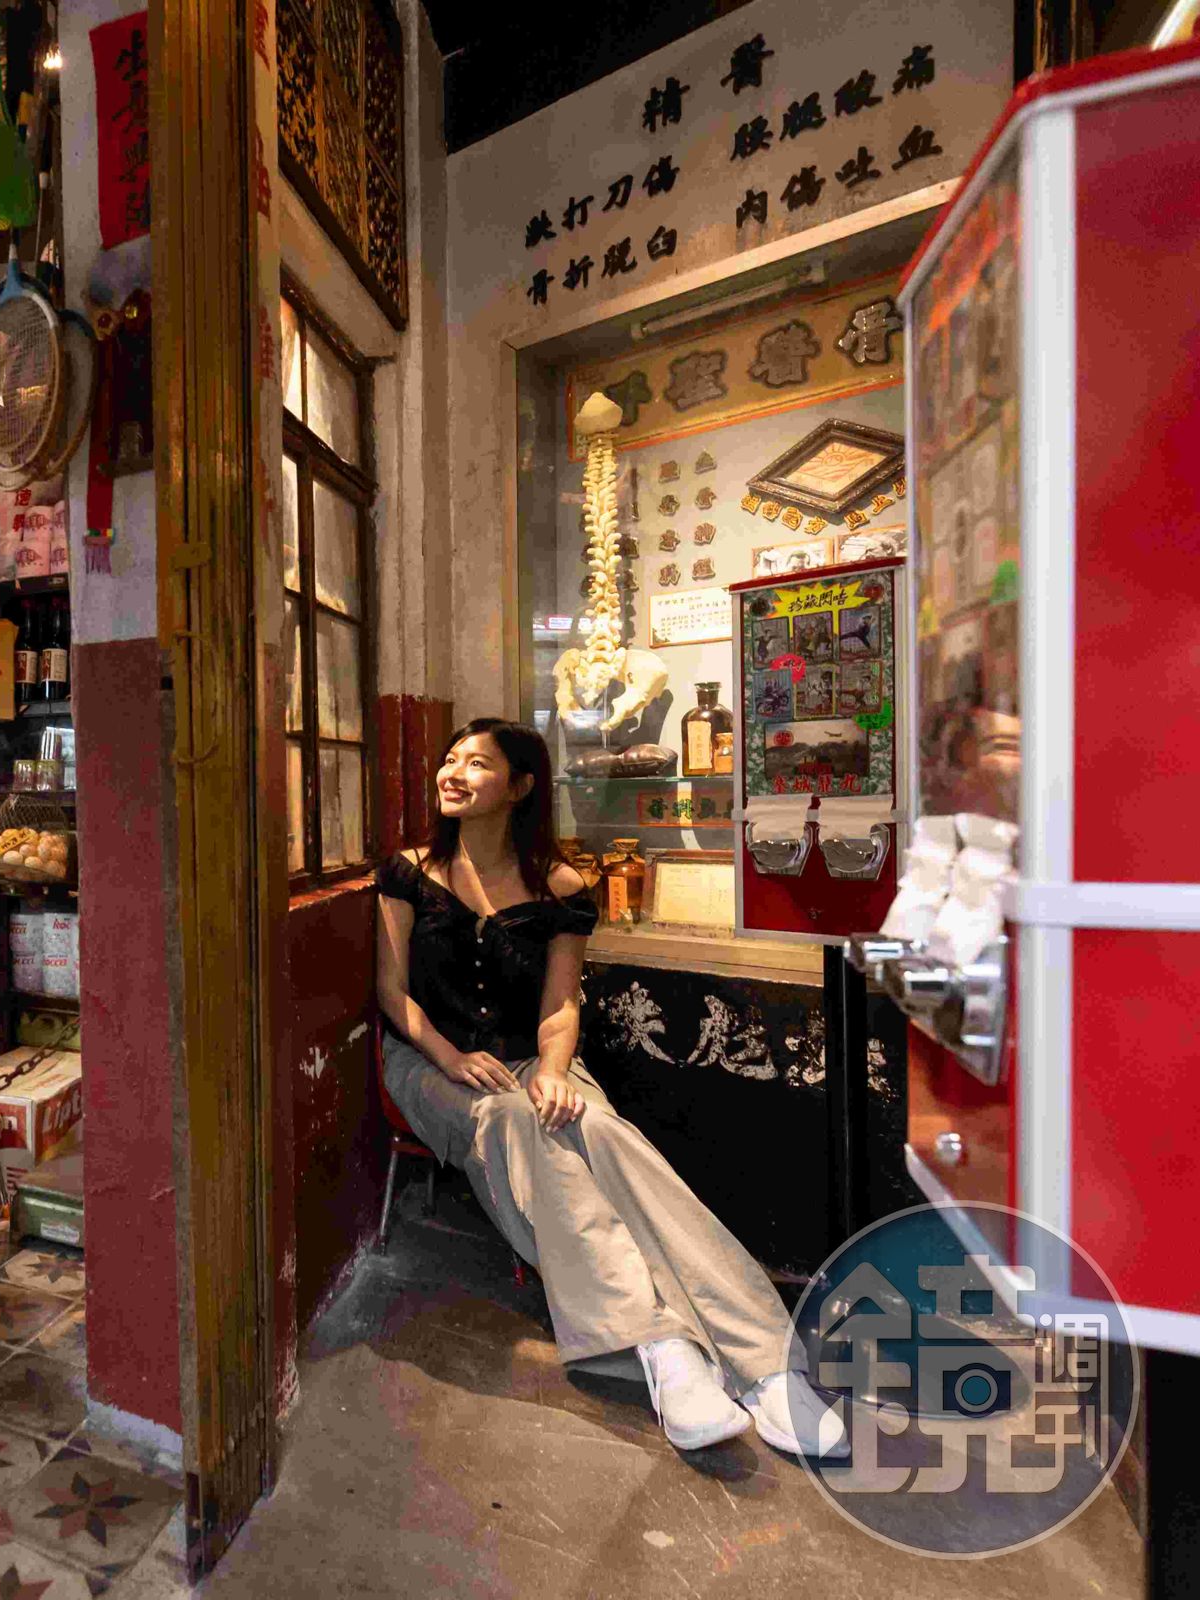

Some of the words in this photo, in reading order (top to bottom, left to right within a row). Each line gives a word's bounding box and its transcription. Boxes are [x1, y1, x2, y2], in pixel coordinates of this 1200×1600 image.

[525, 155, 680, 249] 跌打刀傷
[730, 44, 935, 161] 腰腿酸痛
[42, 1089, 81, 1134] Lipt
